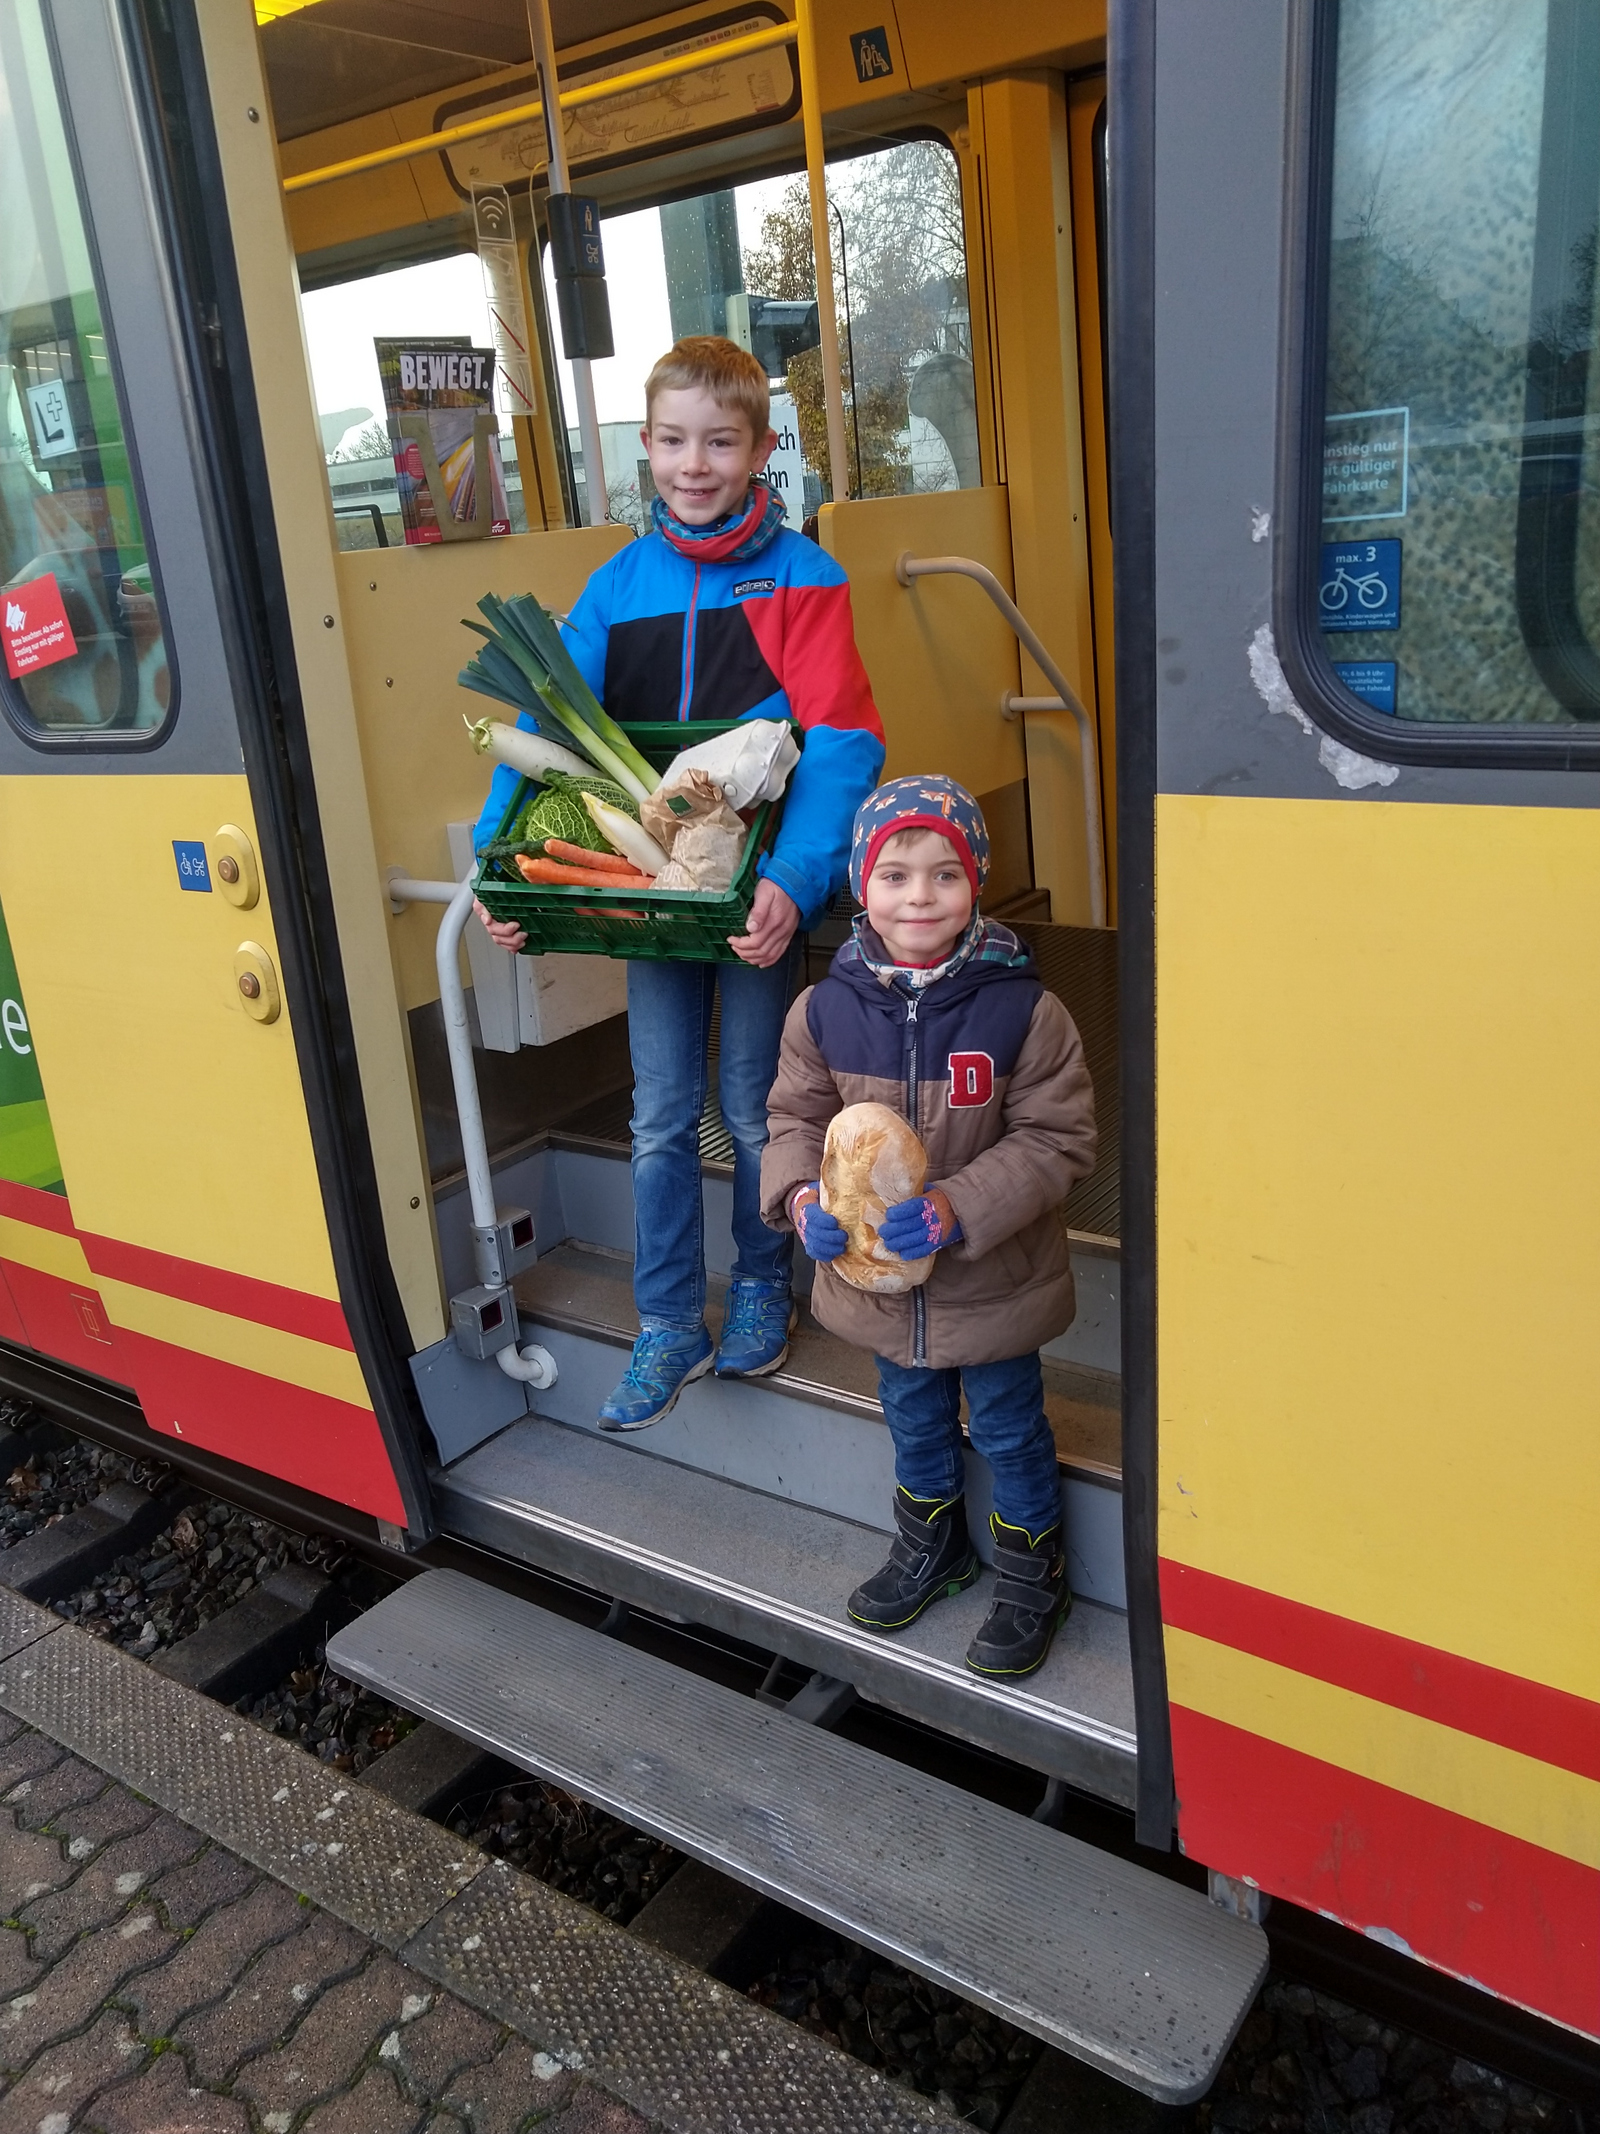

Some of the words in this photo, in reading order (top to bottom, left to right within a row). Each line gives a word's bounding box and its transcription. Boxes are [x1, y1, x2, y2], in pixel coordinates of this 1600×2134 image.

[400, 355, 489, 390] BEWEGT.
[1323, 442, 1370, 458] instieg
[1374, 441, 1398, 453] nur
[1342, 459, 1398, 478] gültiger
[1323, 479, 1389, 494] Fahrkarte
[1336, 553, 1363, 564] max.
[1366, 546, 1377, 563] 3
[11, 638, 22, 648] Bitte
[42, 624, 50, 634] Ab
[49, 620, 64, 632] sofort
[14, 647, 32, 657] Einstieg
[31, 642, 40, 651] nur
[39, 637, 48, 648] mit
[47, 632, 64, 645] gültiger
[947, 1051, 995, 1109] D
